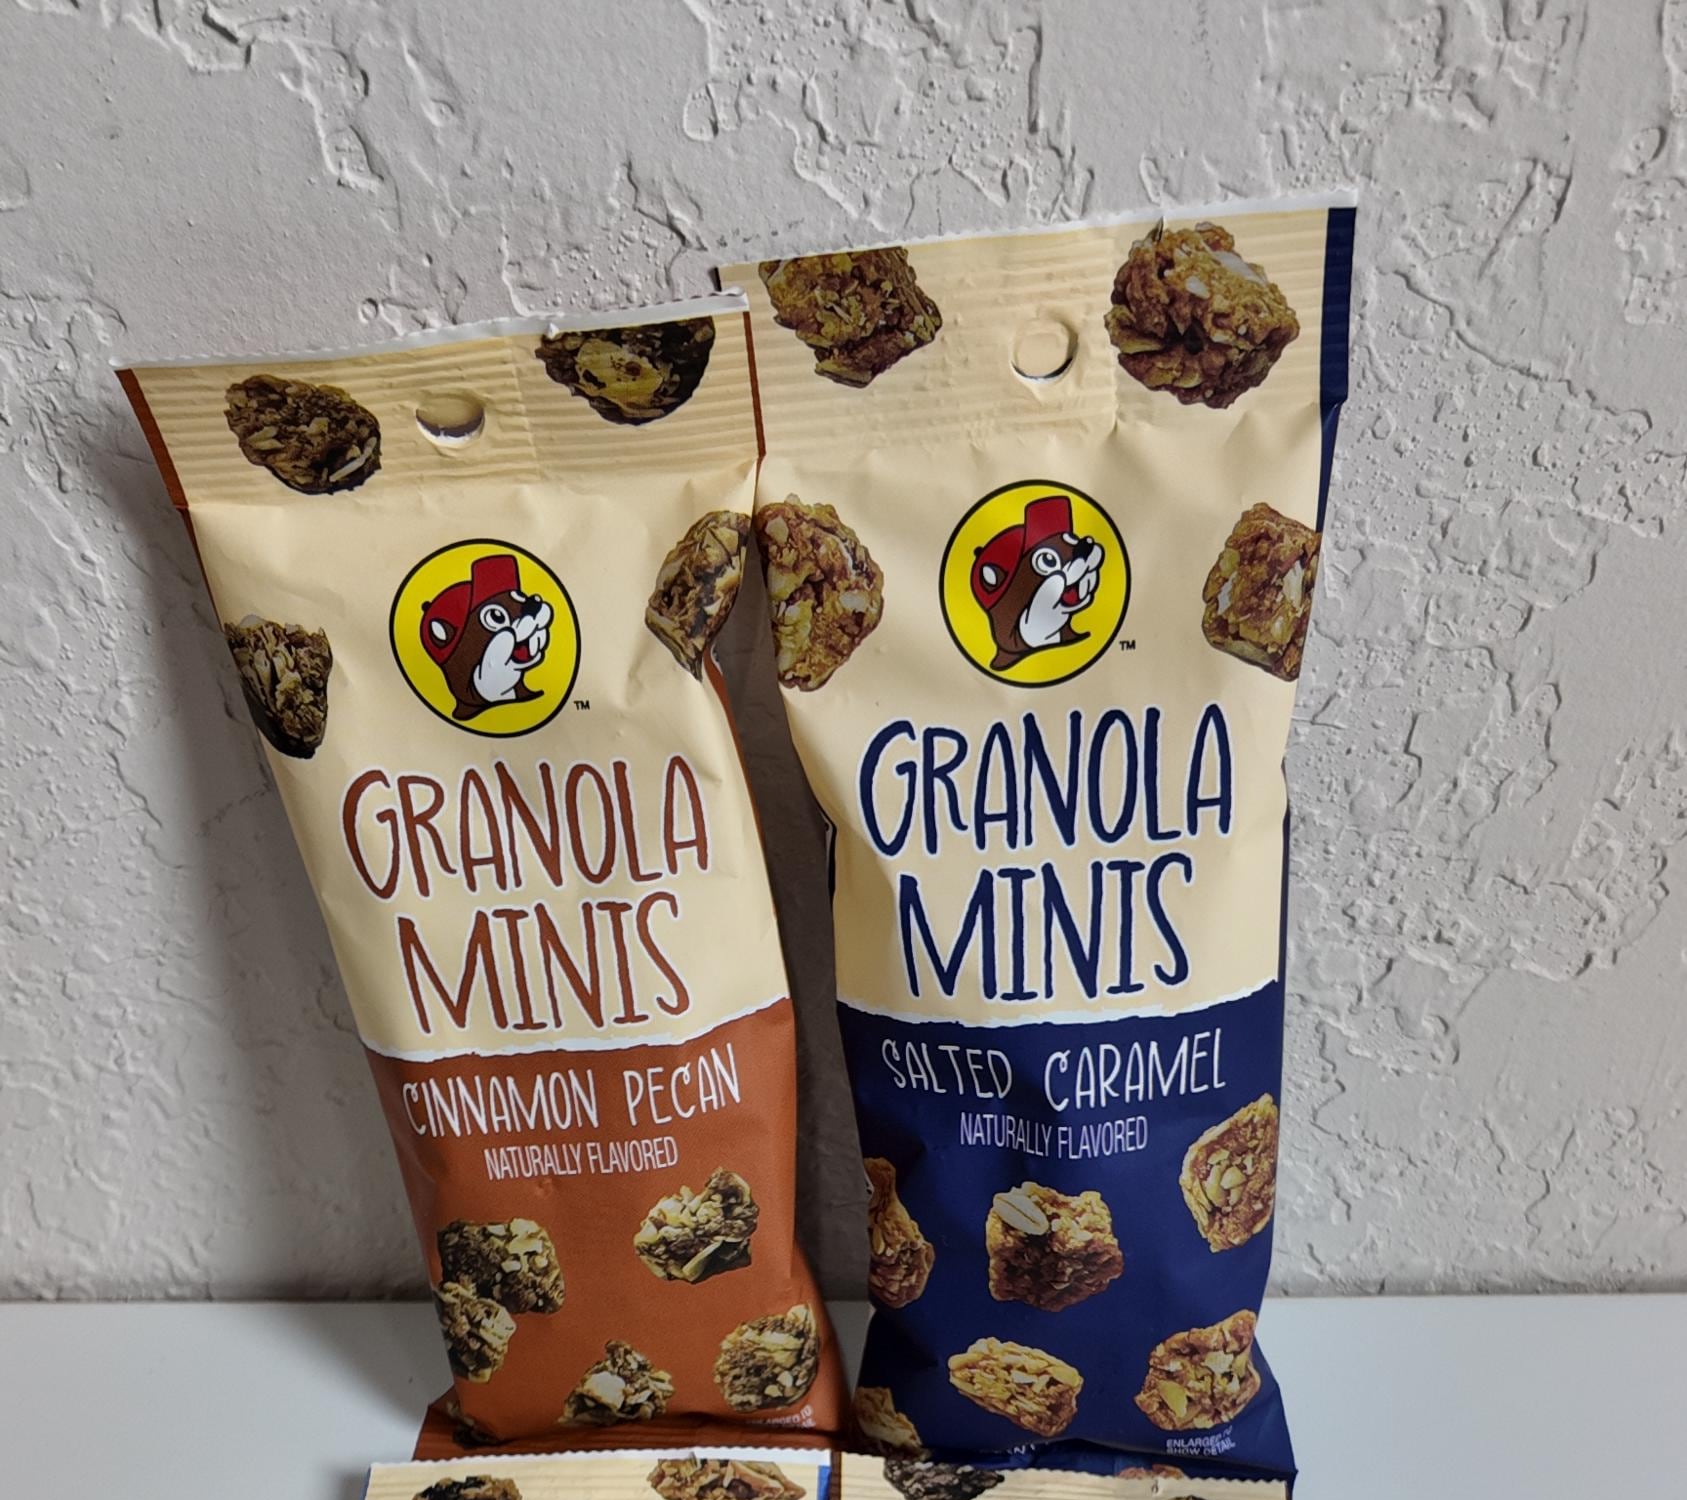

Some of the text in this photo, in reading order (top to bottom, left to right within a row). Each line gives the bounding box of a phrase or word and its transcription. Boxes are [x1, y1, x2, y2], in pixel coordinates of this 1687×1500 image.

[1119, 640, 1136, 651] TM
[573, 699, 590, 711] TM
[860, 704, 1232, 856] GRANOLA
[342, 755, 708, 900] GRANOLA
[398, 891, 691, 1034] MINIS
[899, 852, 1193, 1001] MINIS
[402, 1043, 741, 1138] CINNAMON PECAN
[882, 1029, 1227, 1112] SALTED CARAMEL
[484, 1136, 679, 1181] NATURALLY FLAVORED
[960, 1111, 1148, 1160] NATURALLY FLAVORED
